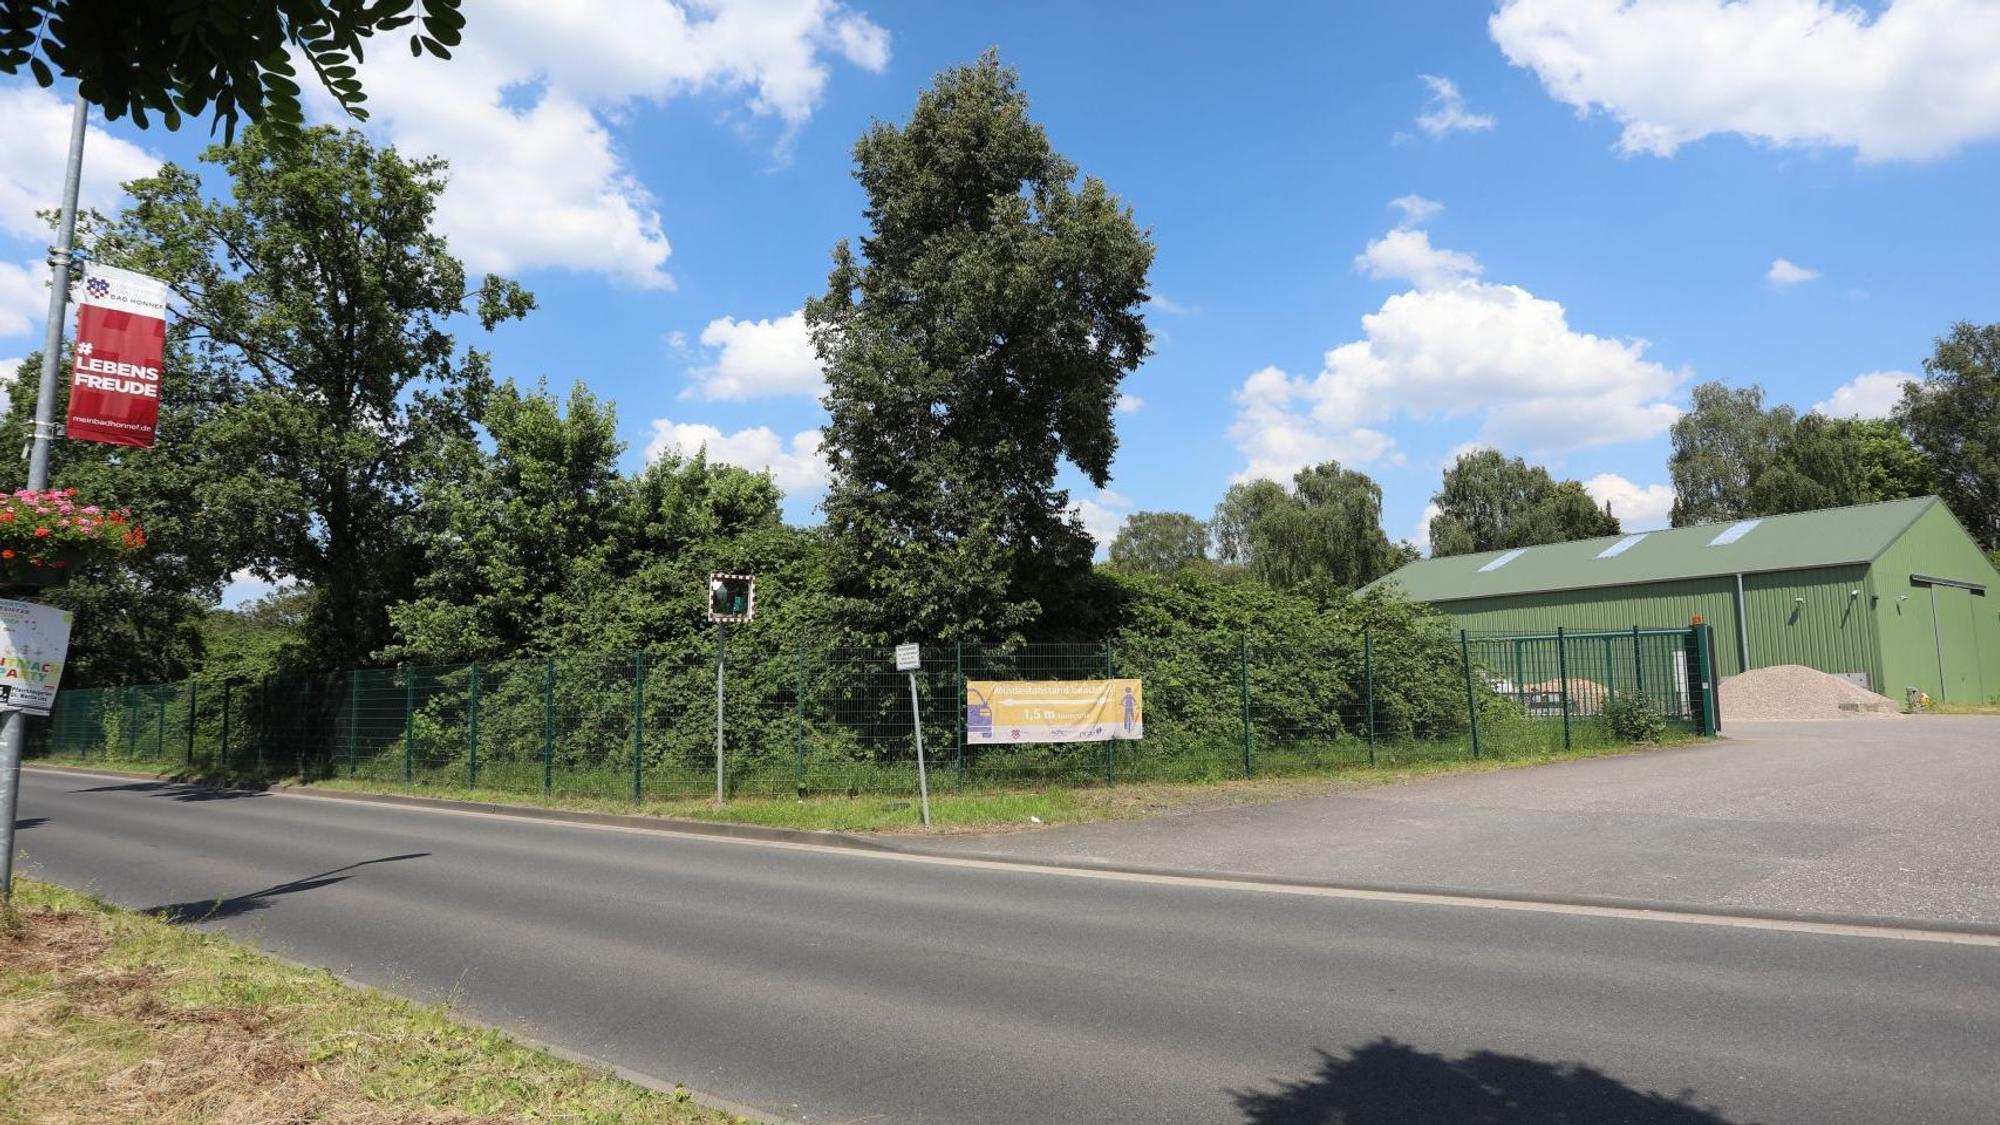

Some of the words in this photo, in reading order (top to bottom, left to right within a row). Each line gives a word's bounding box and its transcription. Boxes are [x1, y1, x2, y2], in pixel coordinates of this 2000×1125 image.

[110, 294, 128, 303] BAD
[77, 342, 93, 356] #
[76, 356, 159, 381] LEBENS
[75, 372, 158, 398] FREUDE
[73, 416, 152, 433] meinbadhonnef.de
[1024, 708, 1041, 721] 1,5
[1044, 711, 1056, 720] m
